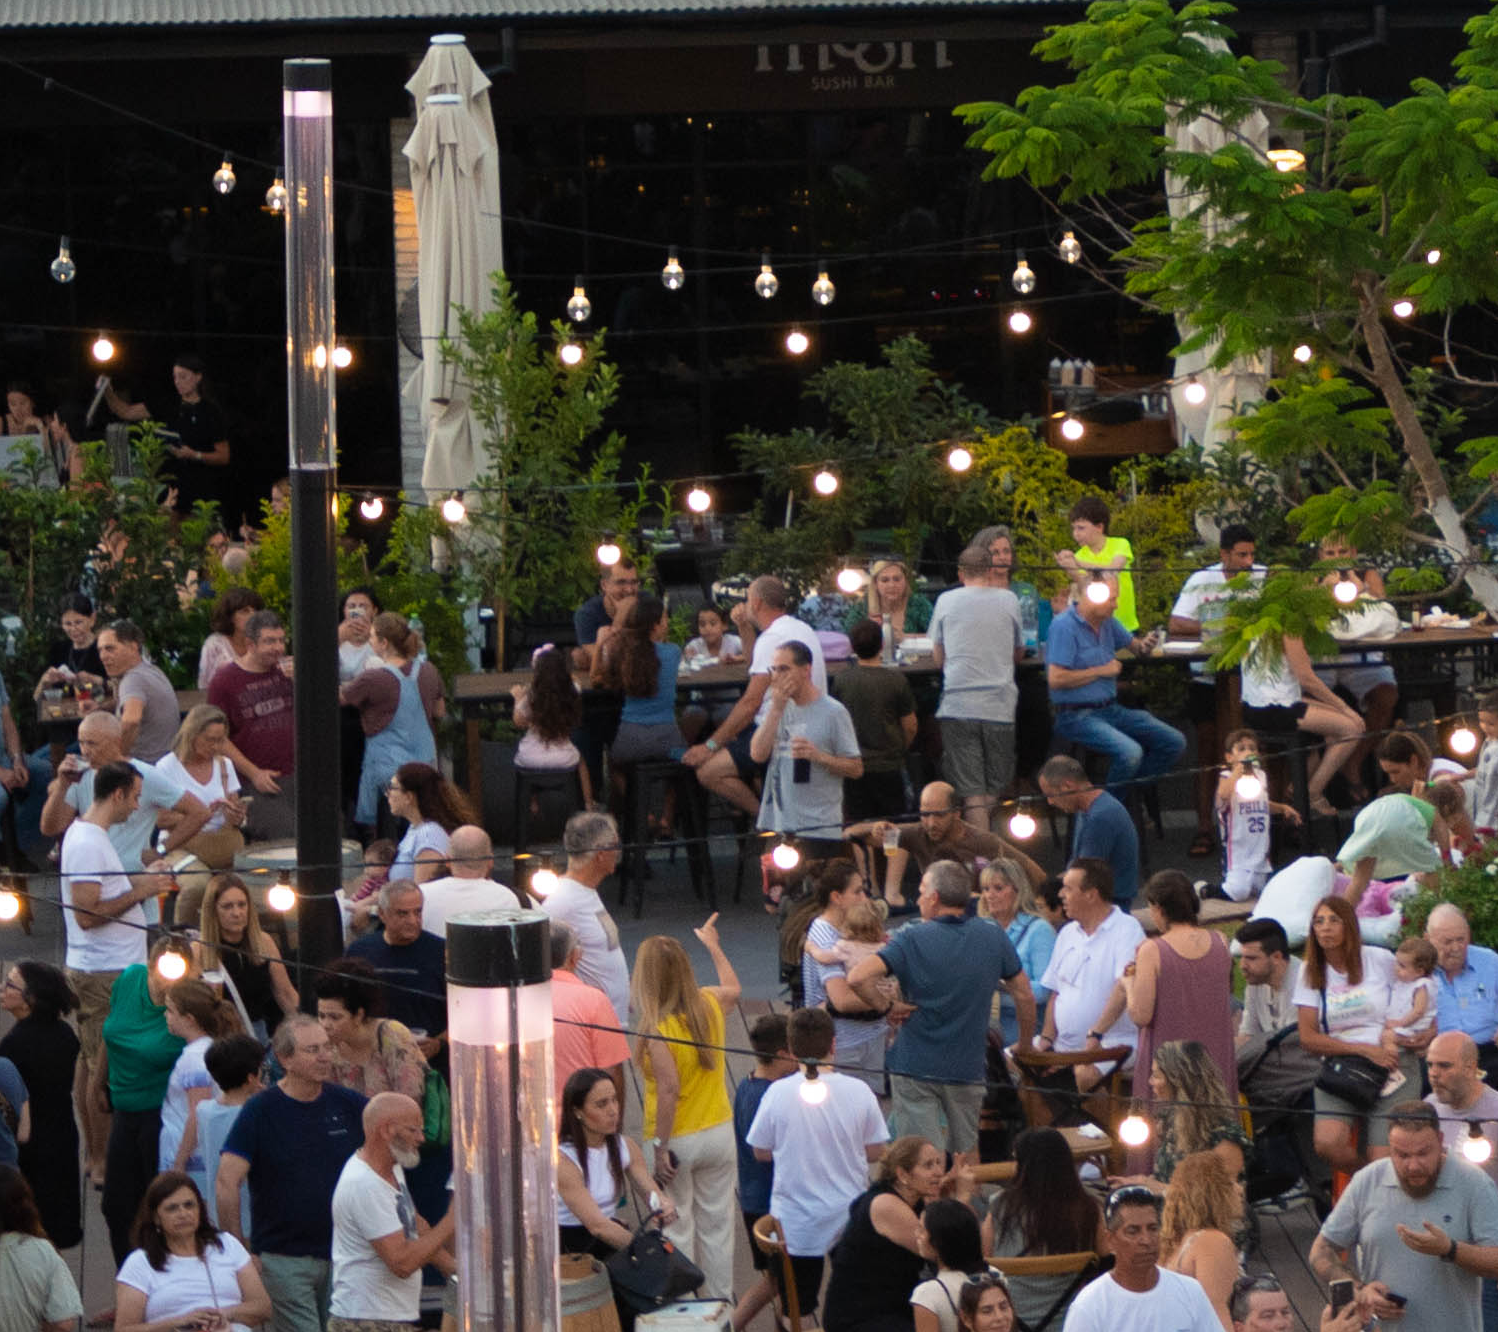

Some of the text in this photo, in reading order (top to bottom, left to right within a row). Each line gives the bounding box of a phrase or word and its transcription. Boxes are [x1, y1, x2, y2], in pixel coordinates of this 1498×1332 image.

[811, 74, 895, 91] SUSHI BAR
[1248, 816, 1265, 834] 25
